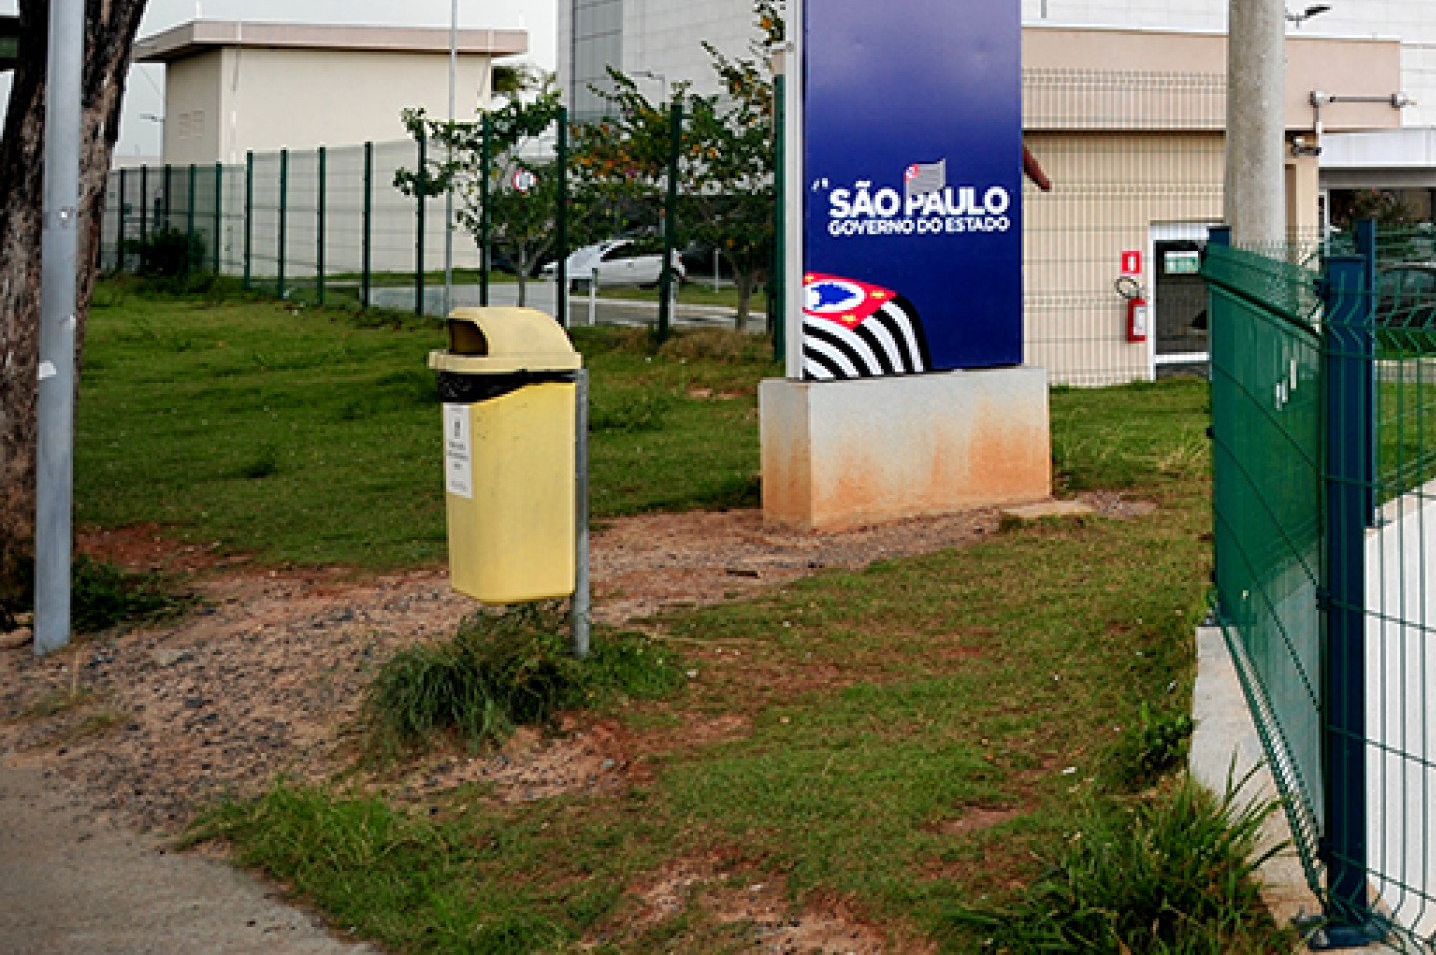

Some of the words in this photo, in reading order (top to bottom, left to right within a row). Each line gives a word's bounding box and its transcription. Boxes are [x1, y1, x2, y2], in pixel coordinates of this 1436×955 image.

[828, 179, 900, 218] SÃO
[905, 186, 1011, 215] PAULO
[827, 218, 915, 235] GOVERNO
[916, 217, 944, 233] DO
[945, 216, 1011, 233] ESTADO
